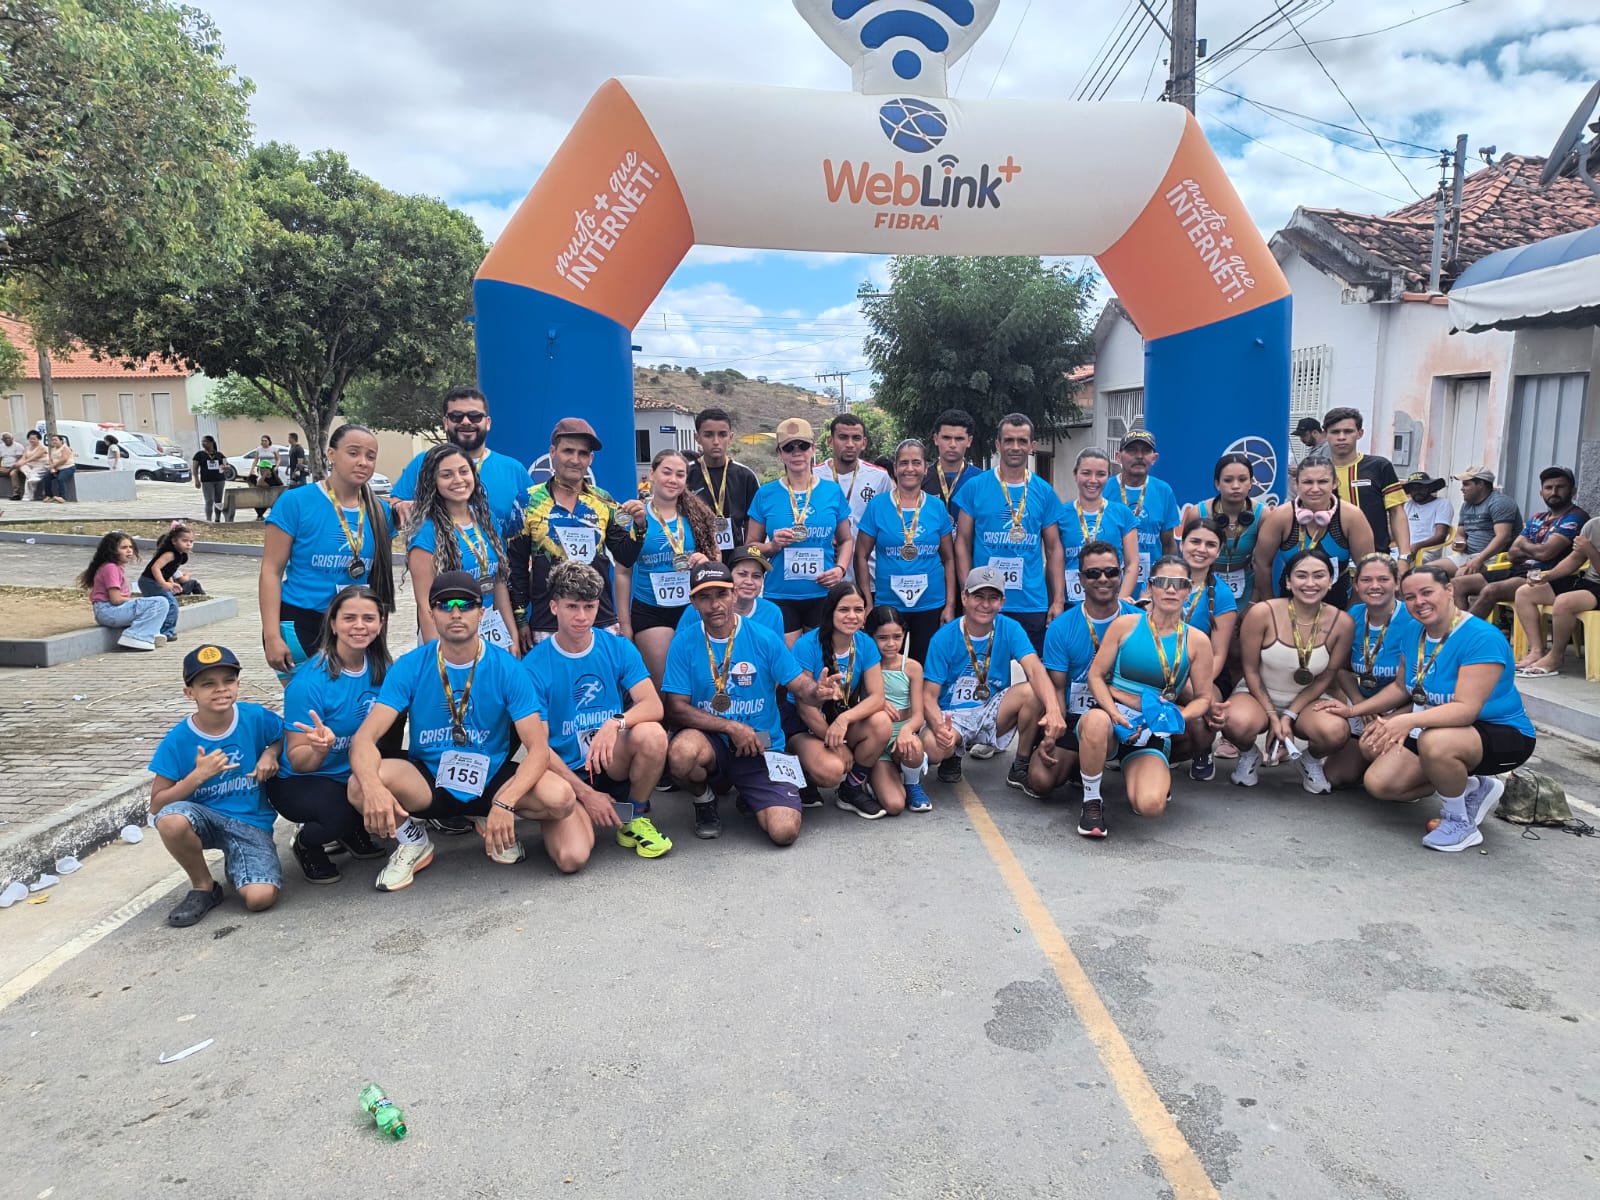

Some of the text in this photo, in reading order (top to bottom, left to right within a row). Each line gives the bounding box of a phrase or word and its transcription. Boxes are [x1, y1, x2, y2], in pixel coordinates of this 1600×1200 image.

[609, 151, 638, 199] que
[566, 160, 661, 291] INTERNET!
[873, 212, 940, 231] FIBRA
[1165, 184, 1245, 303] INTERNET!
[1223, 255, 1255, 289] que
[569, 543, 589, 557] 34
[791, 562, 817, 575] 015
[658, 585, 685, 599] 079
[480, 628, 501, 642] 76
[447, 766, 479, 785] 155
